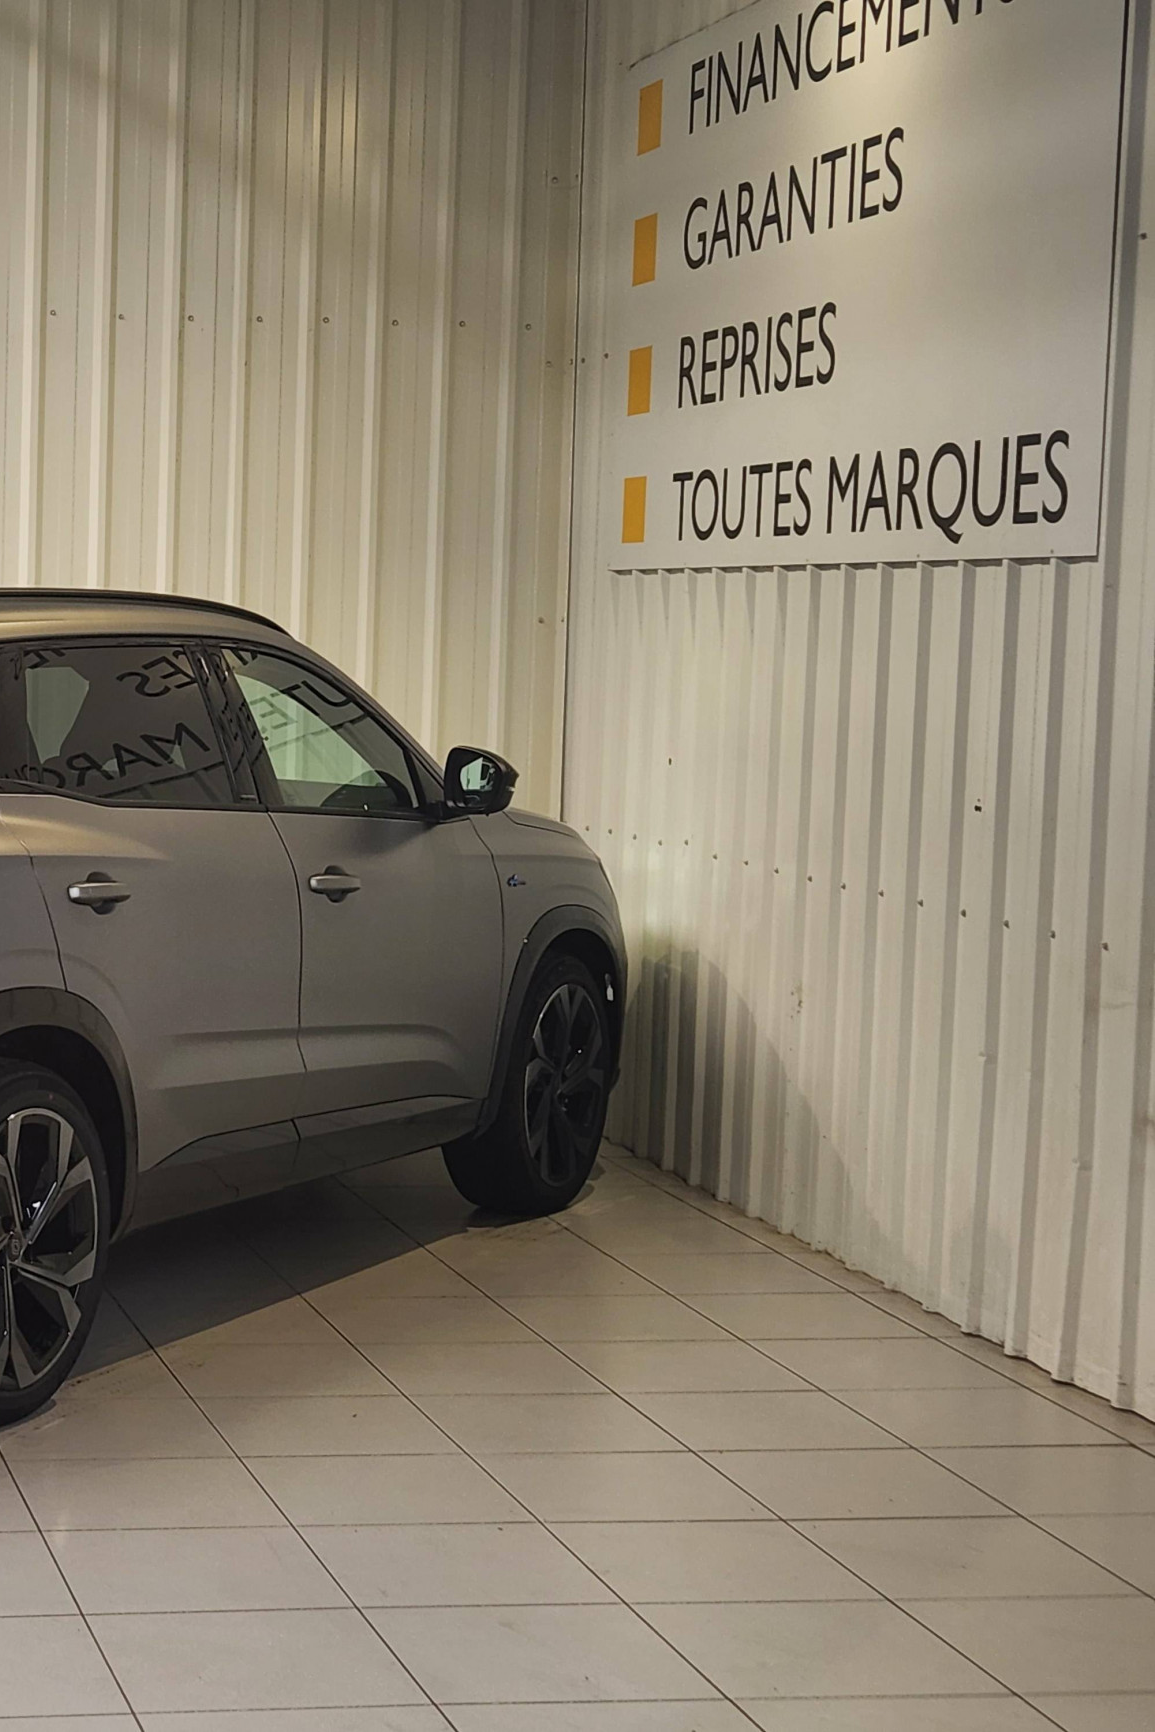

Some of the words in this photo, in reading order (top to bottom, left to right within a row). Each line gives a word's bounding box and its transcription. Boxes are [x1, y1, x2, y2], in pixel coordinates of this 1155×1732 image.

[683, 127, 904, 270] GARANTIES
[678, 301, 837, 409] REPRISES
[672, 458, 812, 541] TOUTES
[826, 430, 1070, 544] MARQUES
